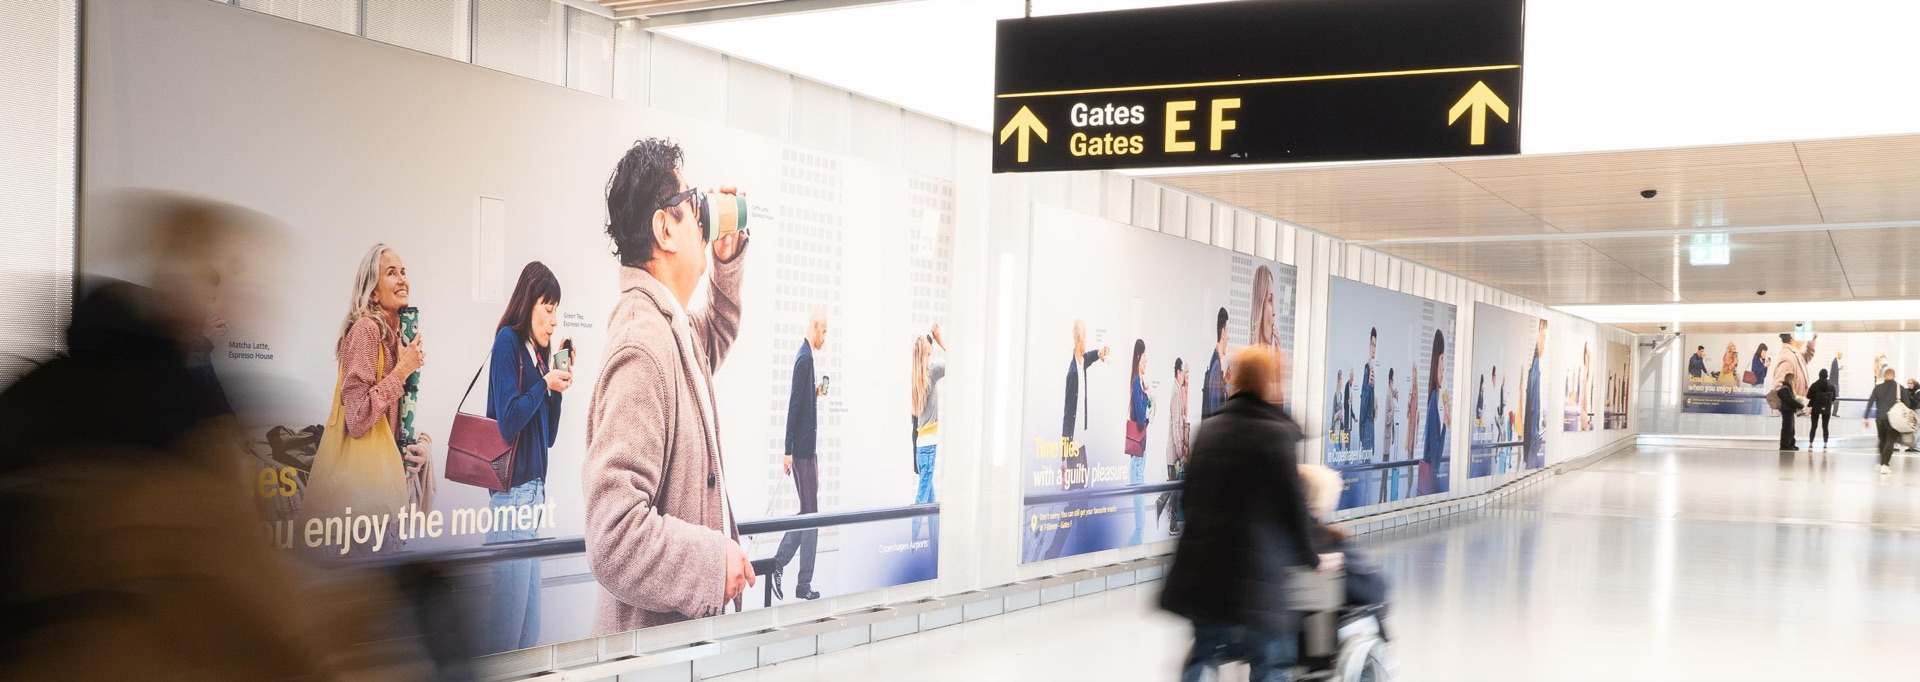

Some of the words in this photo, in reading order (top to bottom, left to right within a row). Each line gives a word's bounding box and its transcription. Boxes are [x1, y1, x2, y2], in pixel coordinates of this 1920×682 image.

[1070, 102, 1145, 127] Gates
[1164, 100, 1197, 153] E
[1209, 97, 1241, 151] F
[1069, 132, 1144, 156] Gates
[228, 341, 252, 349] Matcha
[252, 342, 270, 350] Latte,
[228, 351, 254, 360] Espresso
[255, 352, 274, 360] House
[1035, 437, 1057, 459] Time
[1061, 436, 1079, 458] flies
[1034, 465, 1054, 487] with
[1056, 468, 1063, 486] a
[1065, 463, 1090, 490] guilty
[1092, 462, 1127, 487] pleasure
[304, 506, 390, 555] enjoy
[397, 502, 444, 540] the
[451, 497, 557, 536] moment
[879, 544, 909, 554] Copenhagen
[910, 540, 928, 550] Airports
